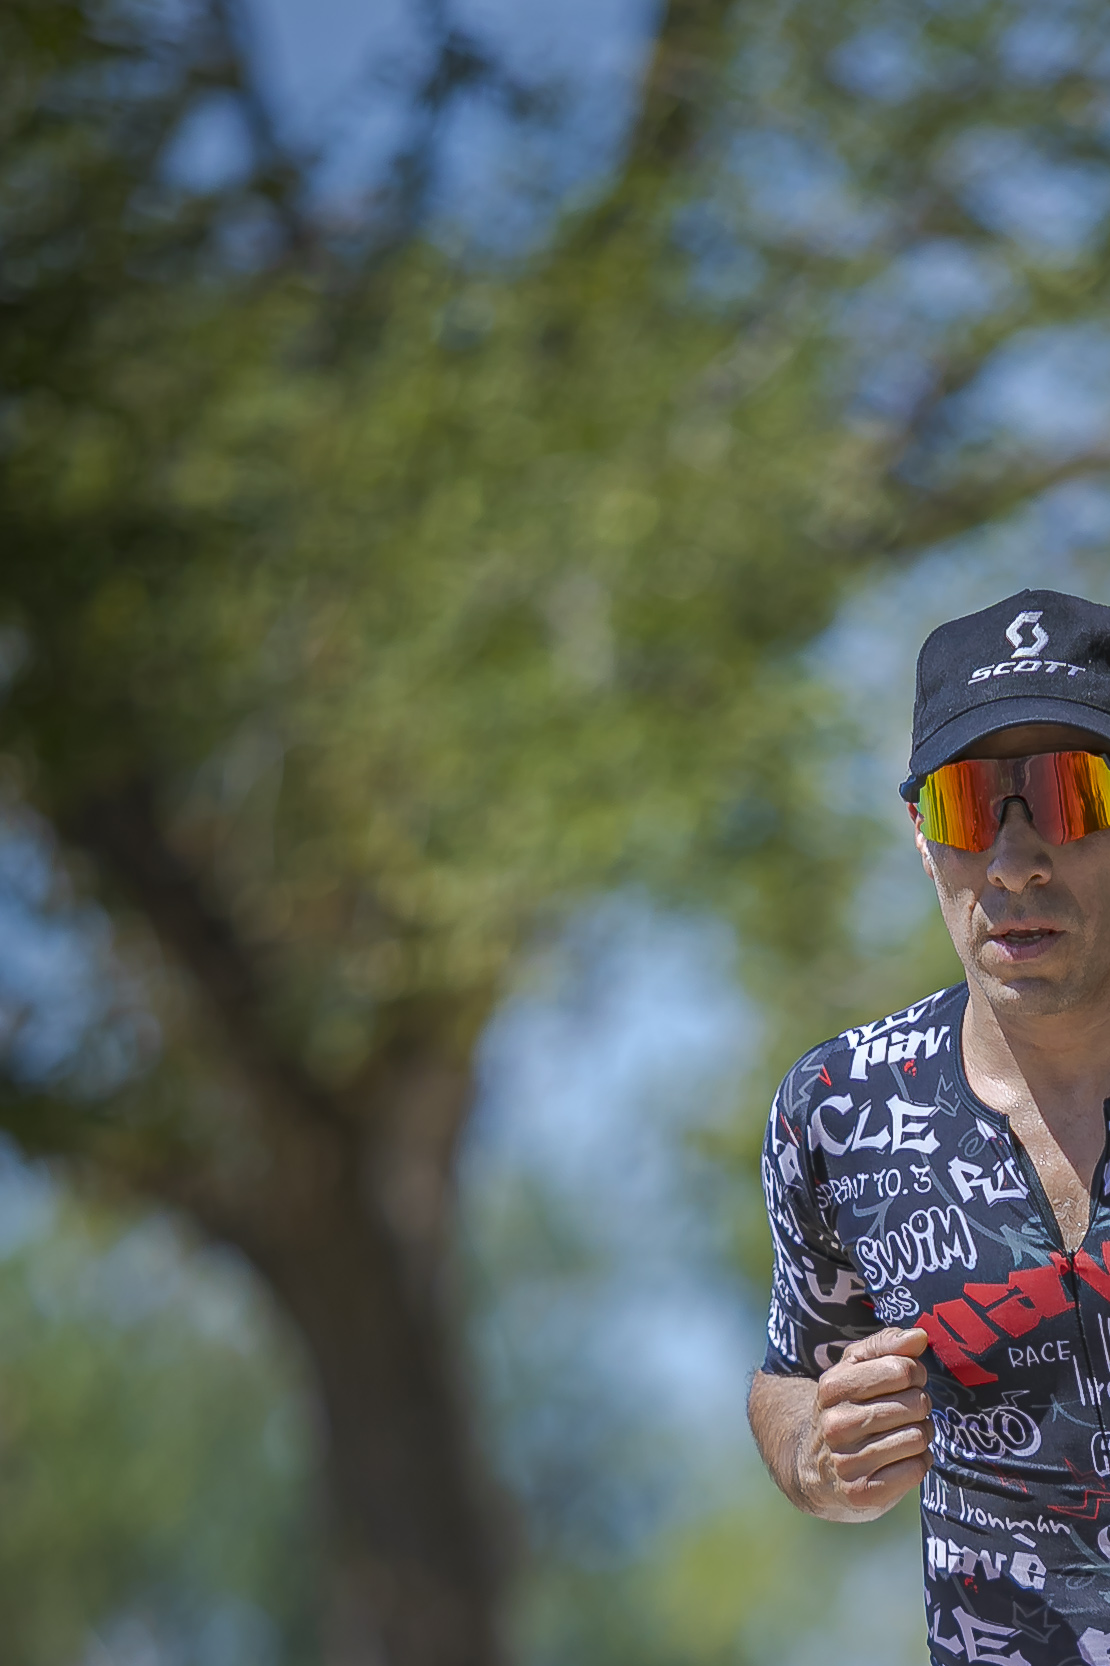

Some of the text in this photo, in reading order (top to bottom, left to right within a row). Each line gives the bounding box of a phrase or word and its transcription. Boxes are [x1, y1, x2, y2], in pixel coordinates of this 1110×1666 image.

[967, 659, 1087, 686] SCOTT
[849, 1025, 951, 1082] pav
[873, 1164, 933, 1201] 70.3
[1007, 1340, 1071, 1369] RACE
[957, 1486, 1071, 1531] Ironman
